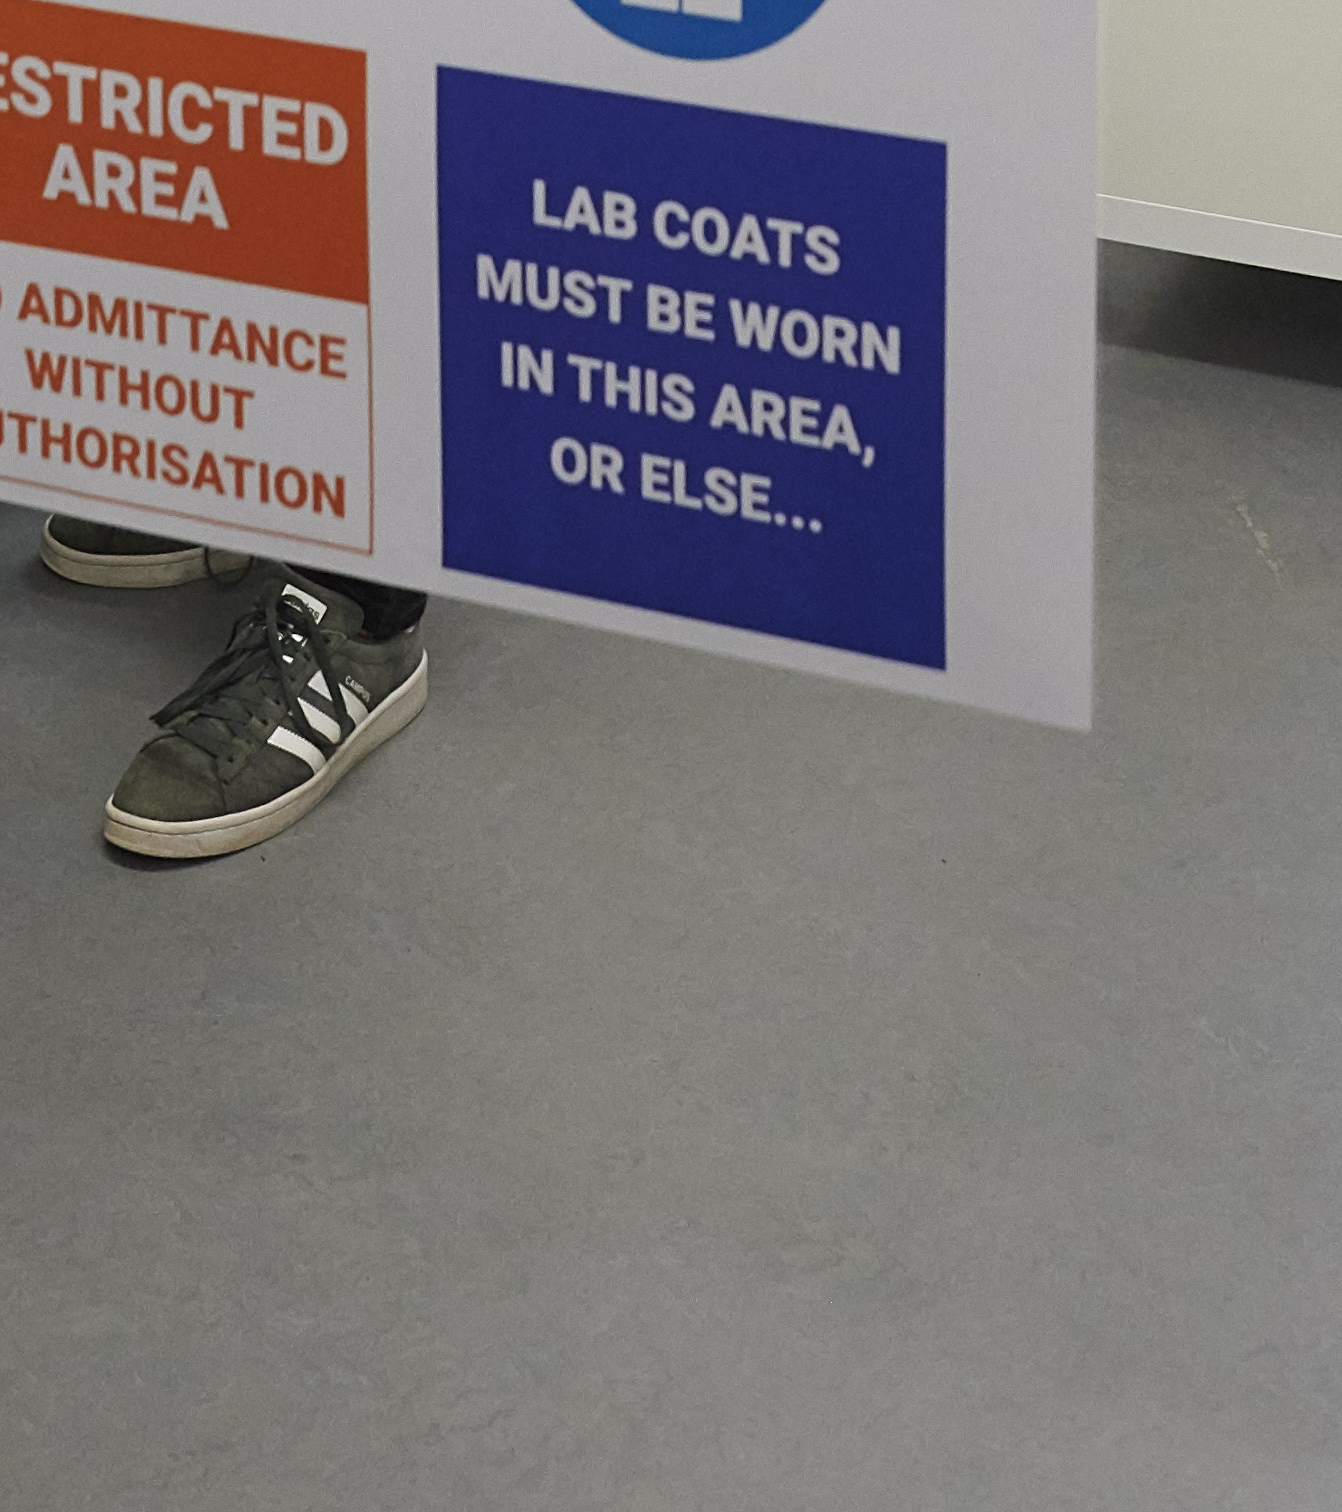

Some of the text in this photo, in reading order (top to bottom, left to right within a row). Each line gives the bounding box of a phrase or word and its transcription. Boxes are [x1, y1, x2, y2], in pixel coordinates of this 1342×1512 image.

[42, 143, 230, 230] AREA
[533, 178, 841, 276] LAB COATS
[17, 282, 348, 379] ADMITTANCE
[476, 253, 900, 375] MUST BE WORN
[25, 348, 254, 430] WITHOUT
[500, 340, 876, 468] IN THIS AREA,
[550, 436, 823, 534] OR ELSE...
